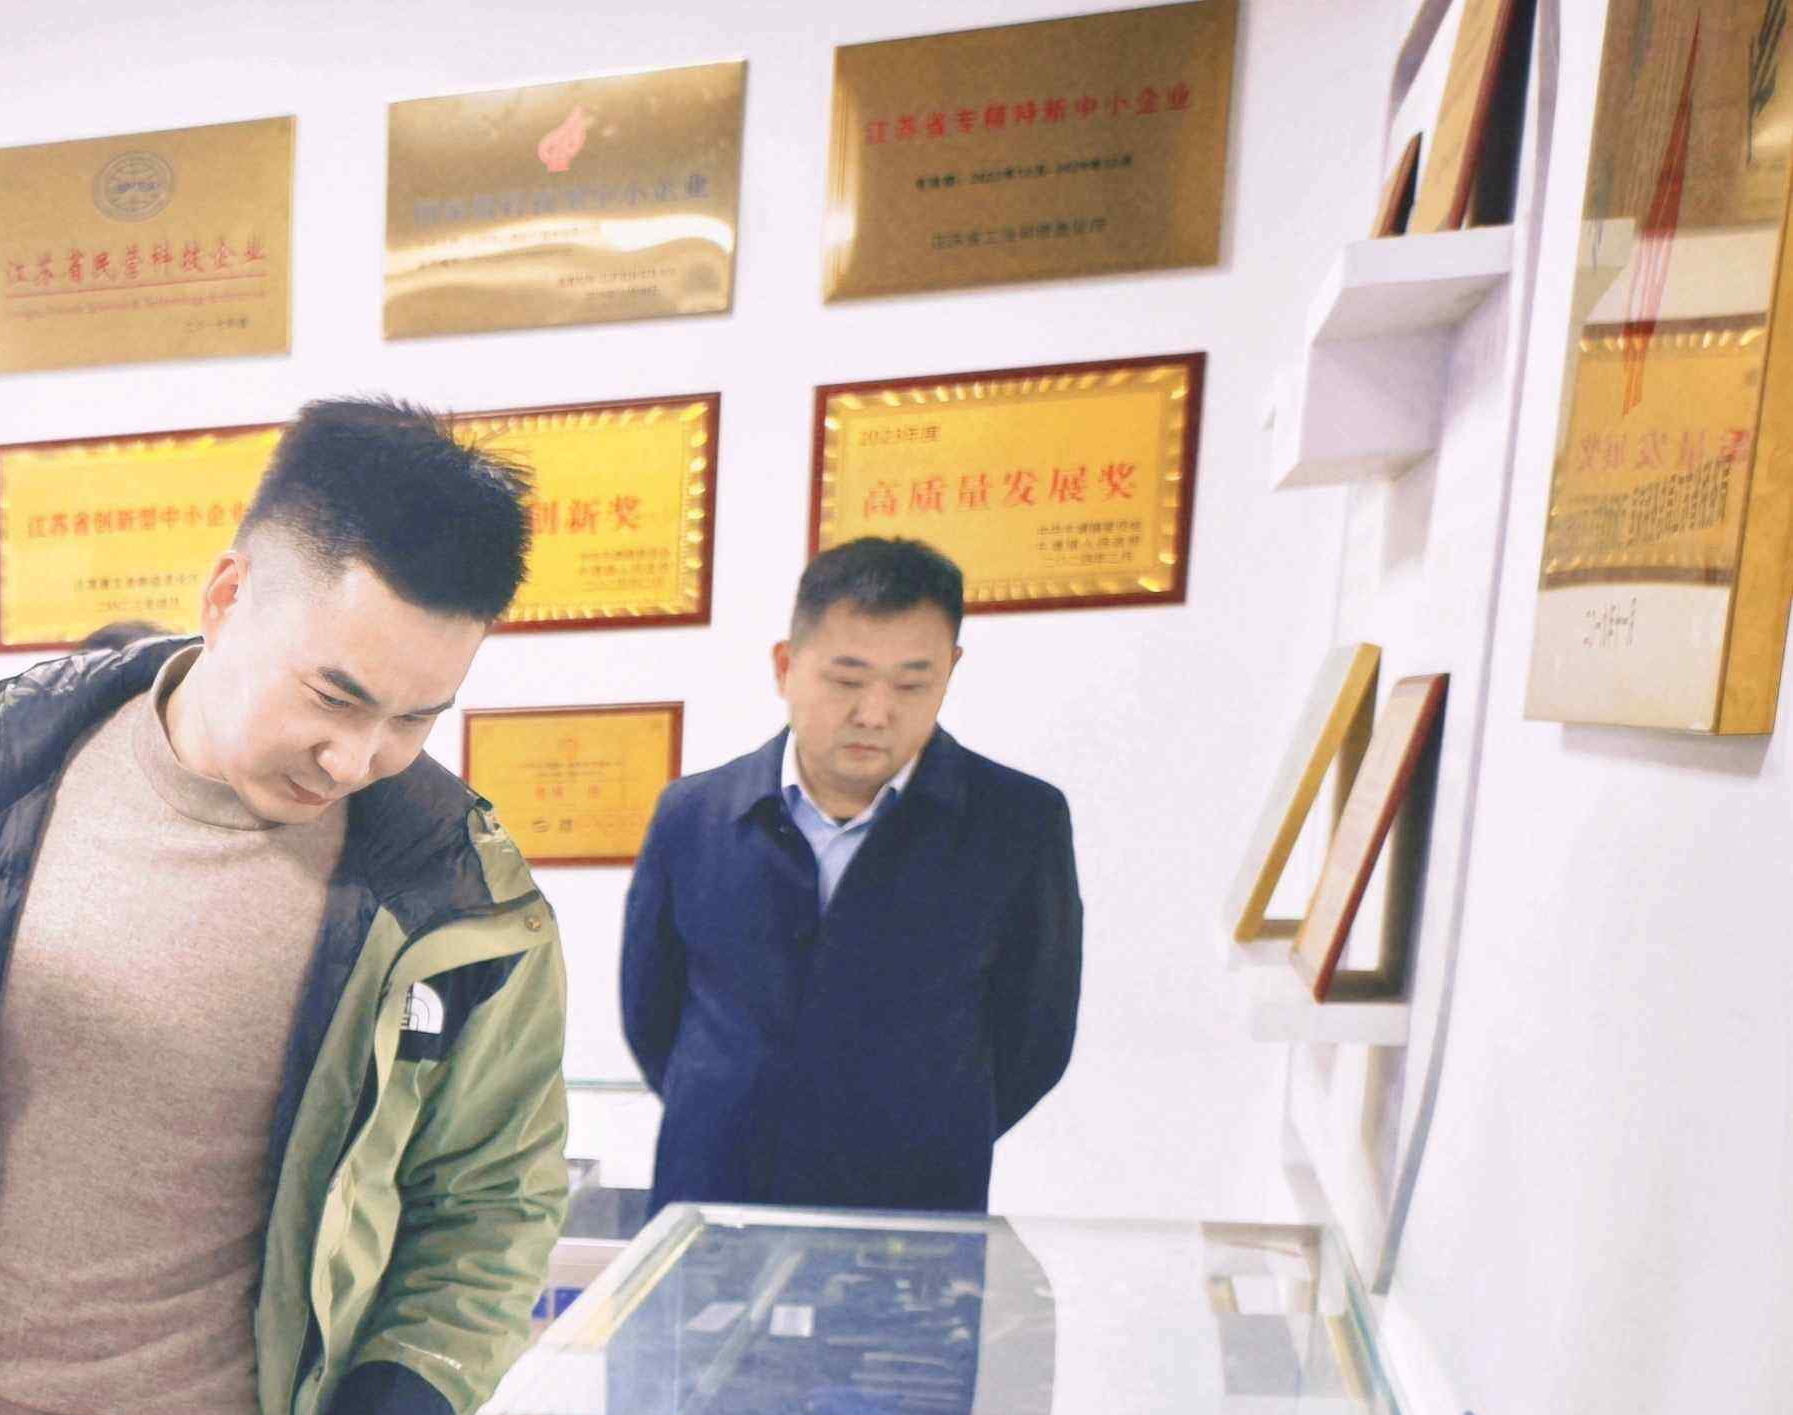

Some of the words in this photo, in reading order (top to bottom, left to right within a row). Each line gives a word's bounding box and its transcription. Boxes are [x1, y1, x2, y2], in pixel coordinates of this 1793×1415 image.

[862, 460, 1138, 520] 高质量发展奖
